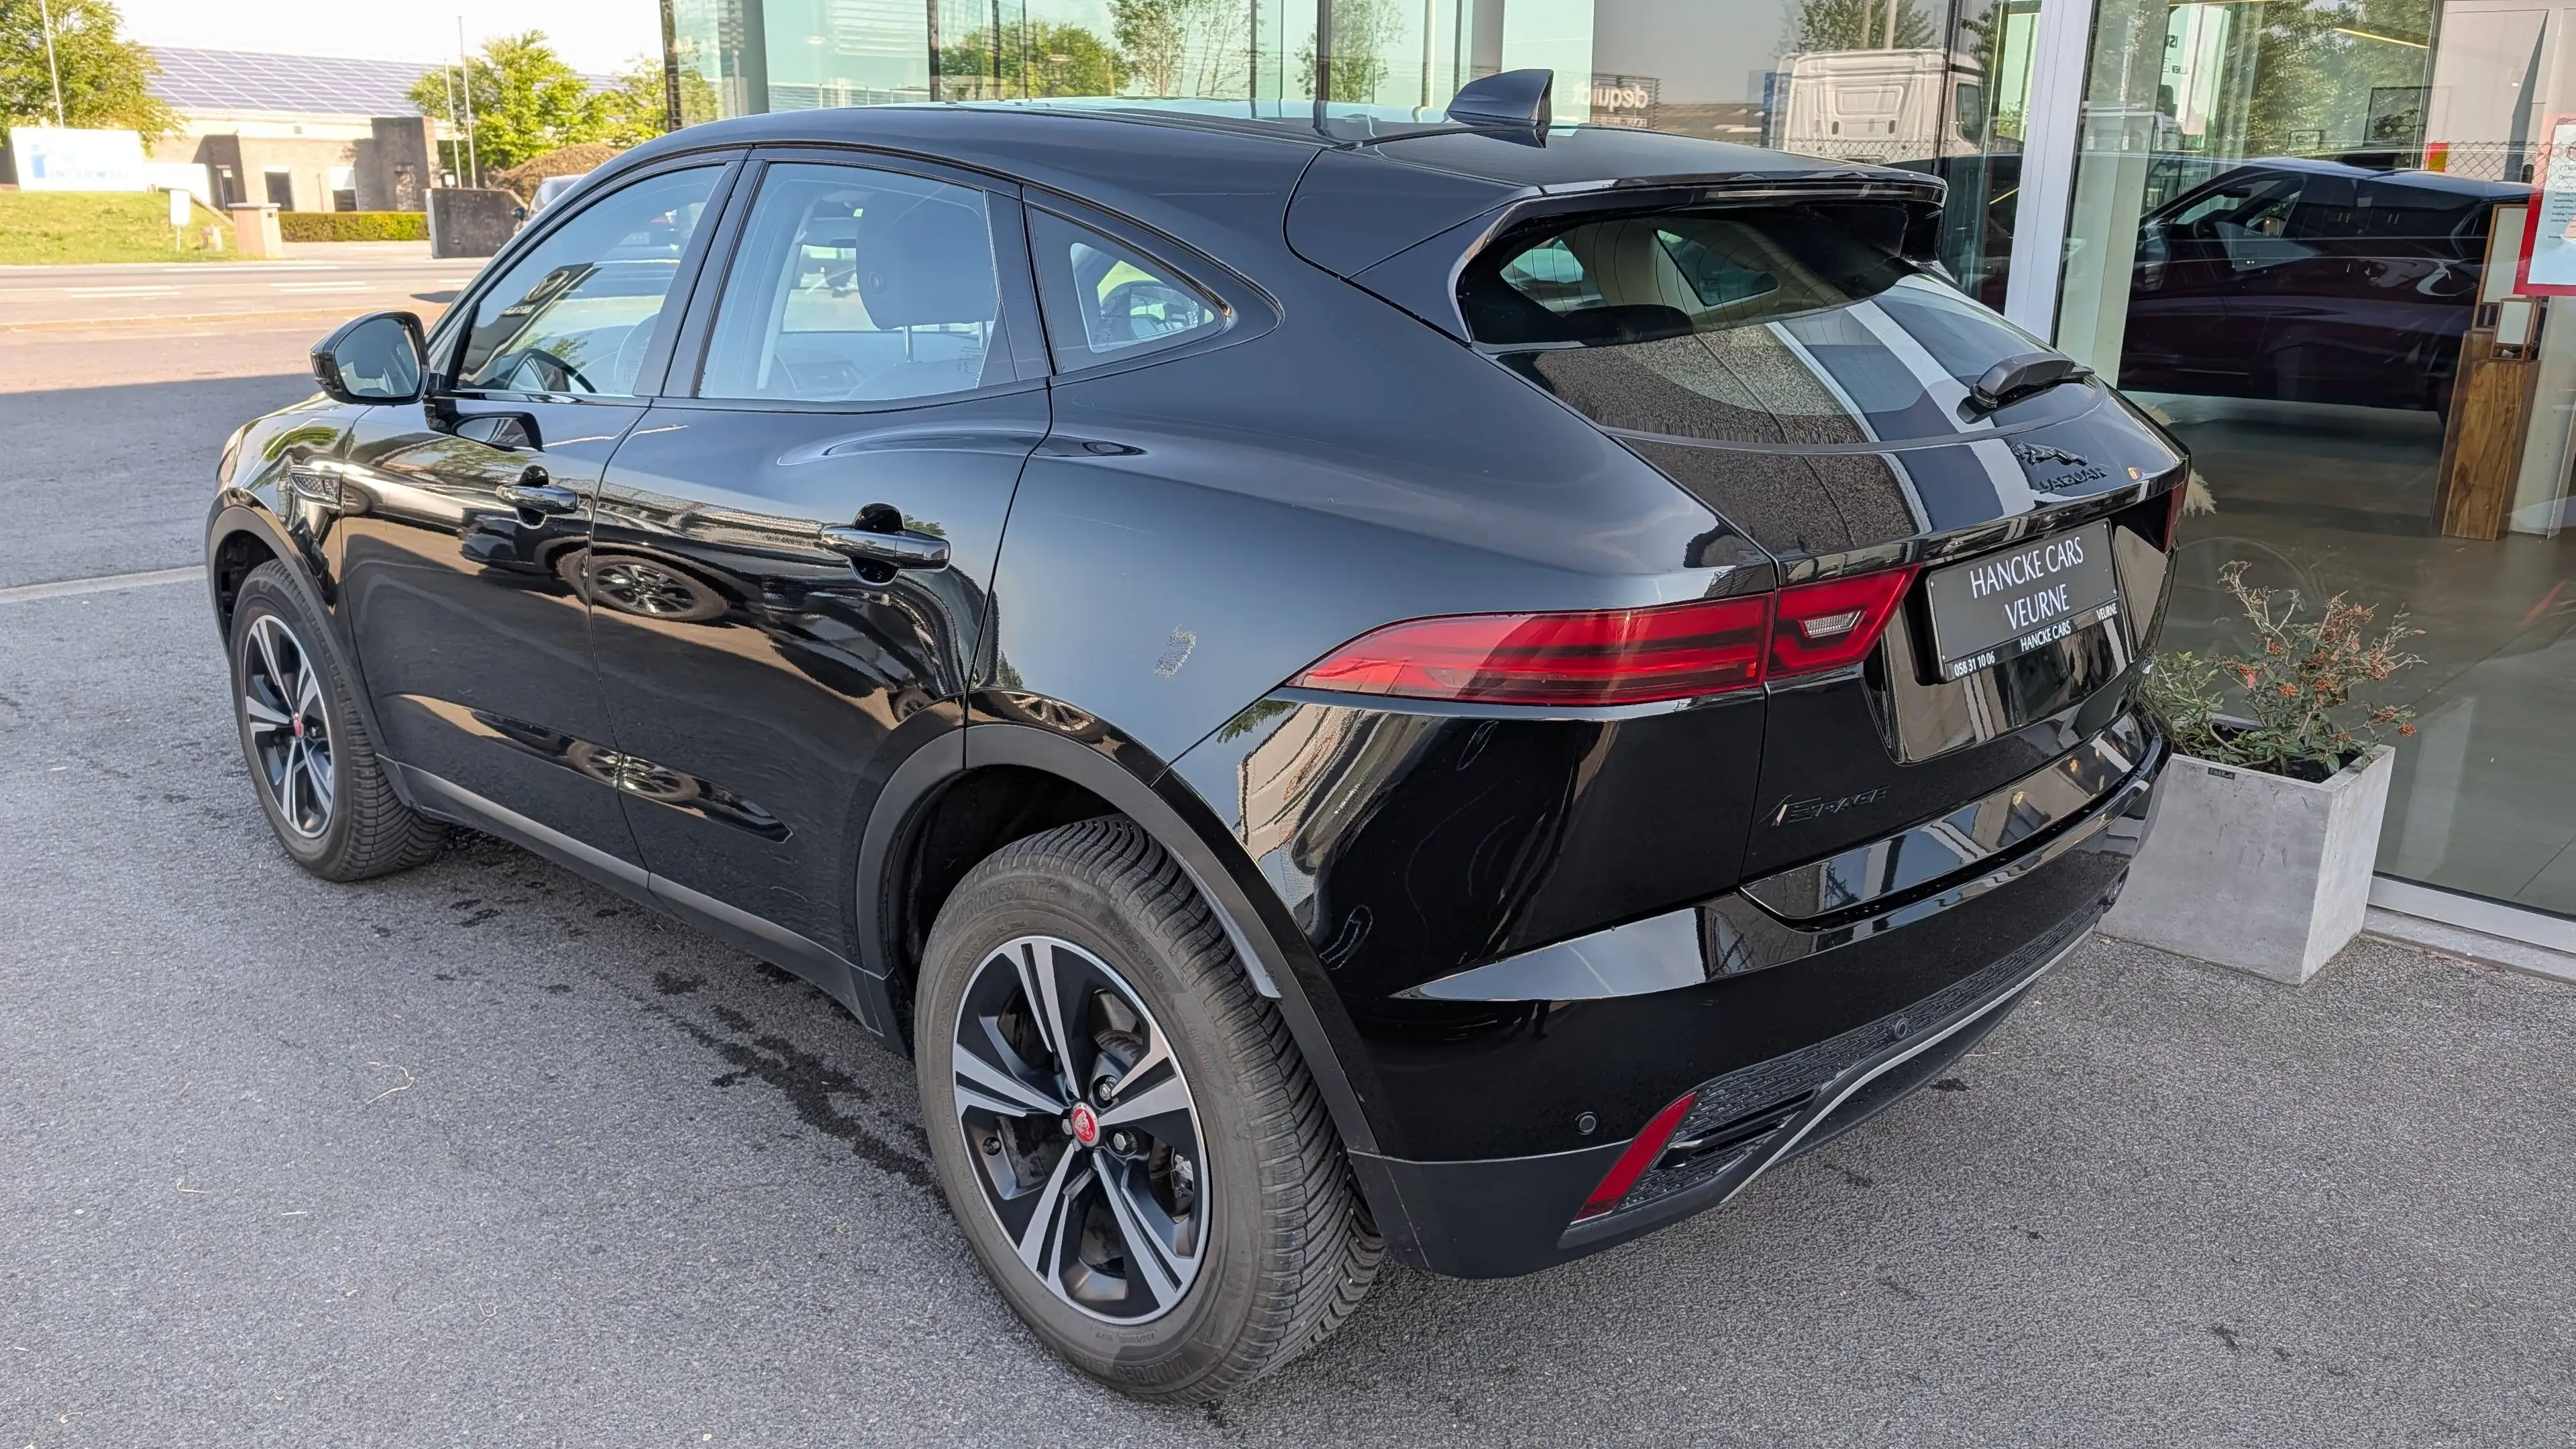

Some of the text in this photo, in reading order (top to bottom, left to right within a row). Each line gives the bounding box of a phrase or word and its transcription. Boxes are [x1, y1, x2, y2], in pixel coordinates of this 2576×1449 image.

[2039, 468, 2107, 494] JAGUAR
[1970, 536, 2084, 598] HANCKE CARS
[2004, 583, 2070, 631] VEURNE
[2096, 602, 2118, 621] VEURNE
[2020, 621, 2072, 652] HANCKE CARS
[1954, 651, 1995, 676] 058 31 10 06
